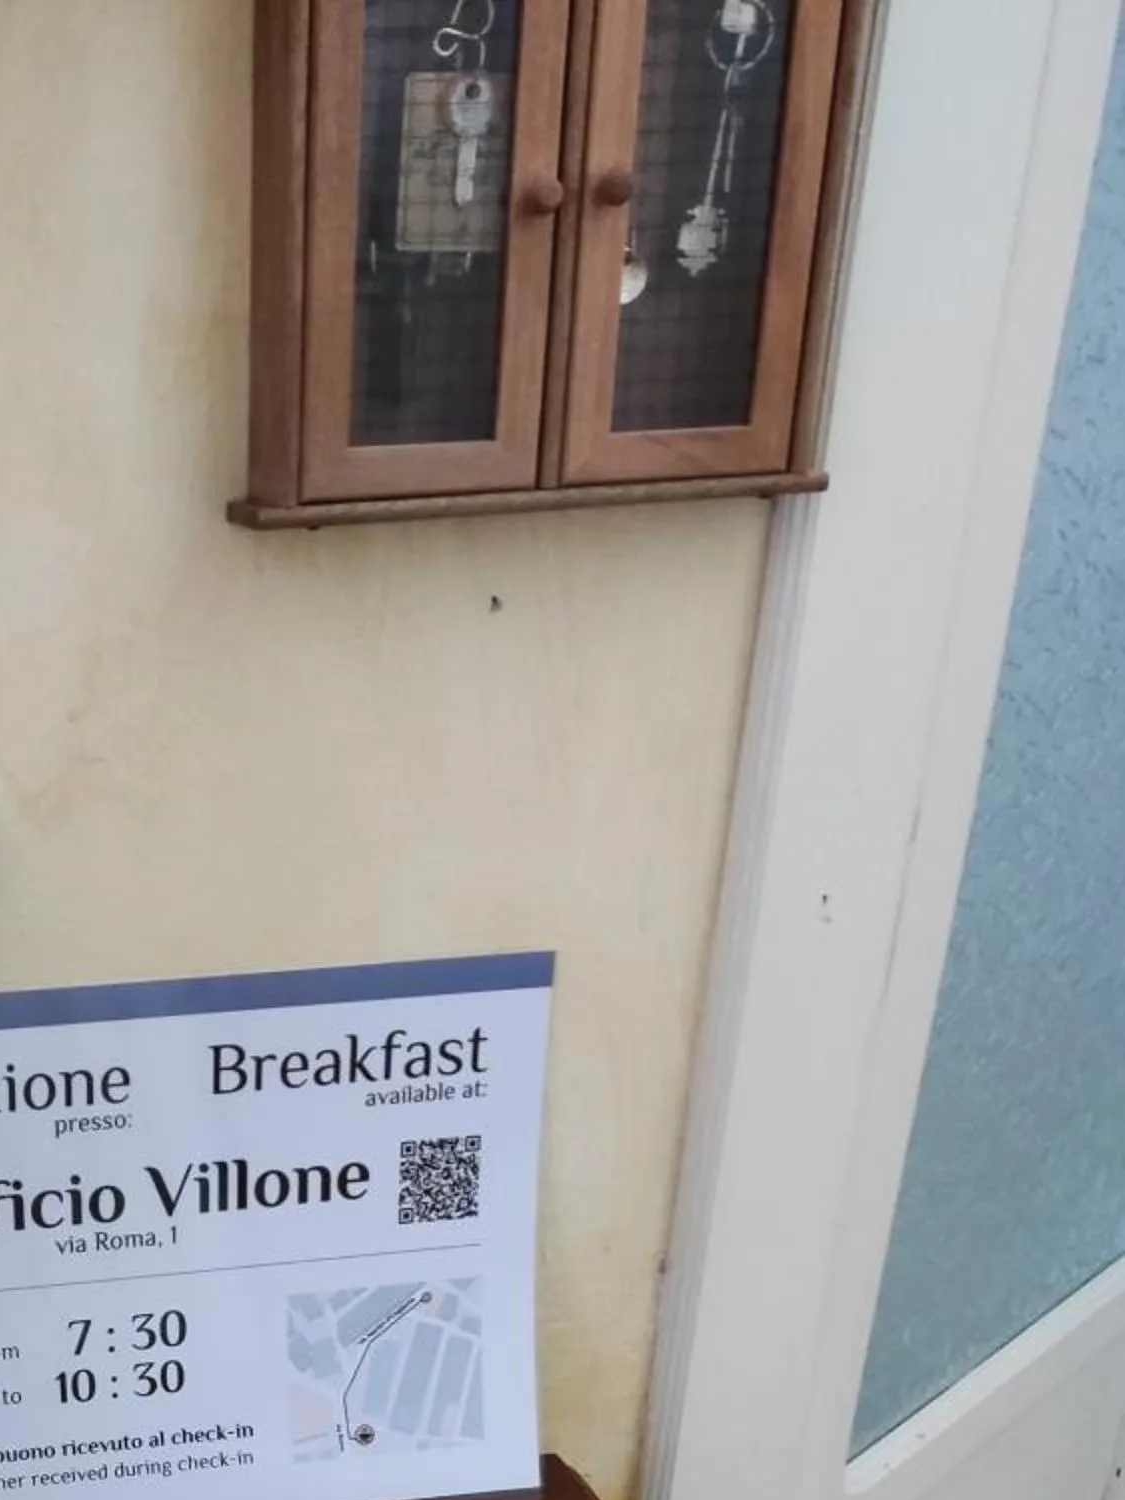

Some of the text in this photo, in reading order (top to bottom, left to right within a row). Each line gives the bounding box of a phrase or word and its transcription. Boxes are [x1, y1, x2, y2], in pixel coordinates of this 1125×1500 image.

[208, 1027, 489, 1096] Breakfast
[364, 1080, 489, 1108] available at:
[54, 1111, 133, 1138] presso:
[144, 1159, 371, 1218] Villone
[55, 1232, 87, 1255] via
[94, 1229, 163, 1251] Roma,
[1, 1387, 23, 1406] to
[55, 1369, 96, 1404] 10
[62, 1435, 143, 1461] ricevuto
[149, 1430, 165, 1449] al
[171, 1423, 255, 1446] check-in
[30, 1462, 109, 1488] received
[113, 1456, 173, 1480] during
[177, 1450, 255, 1473] check-in
